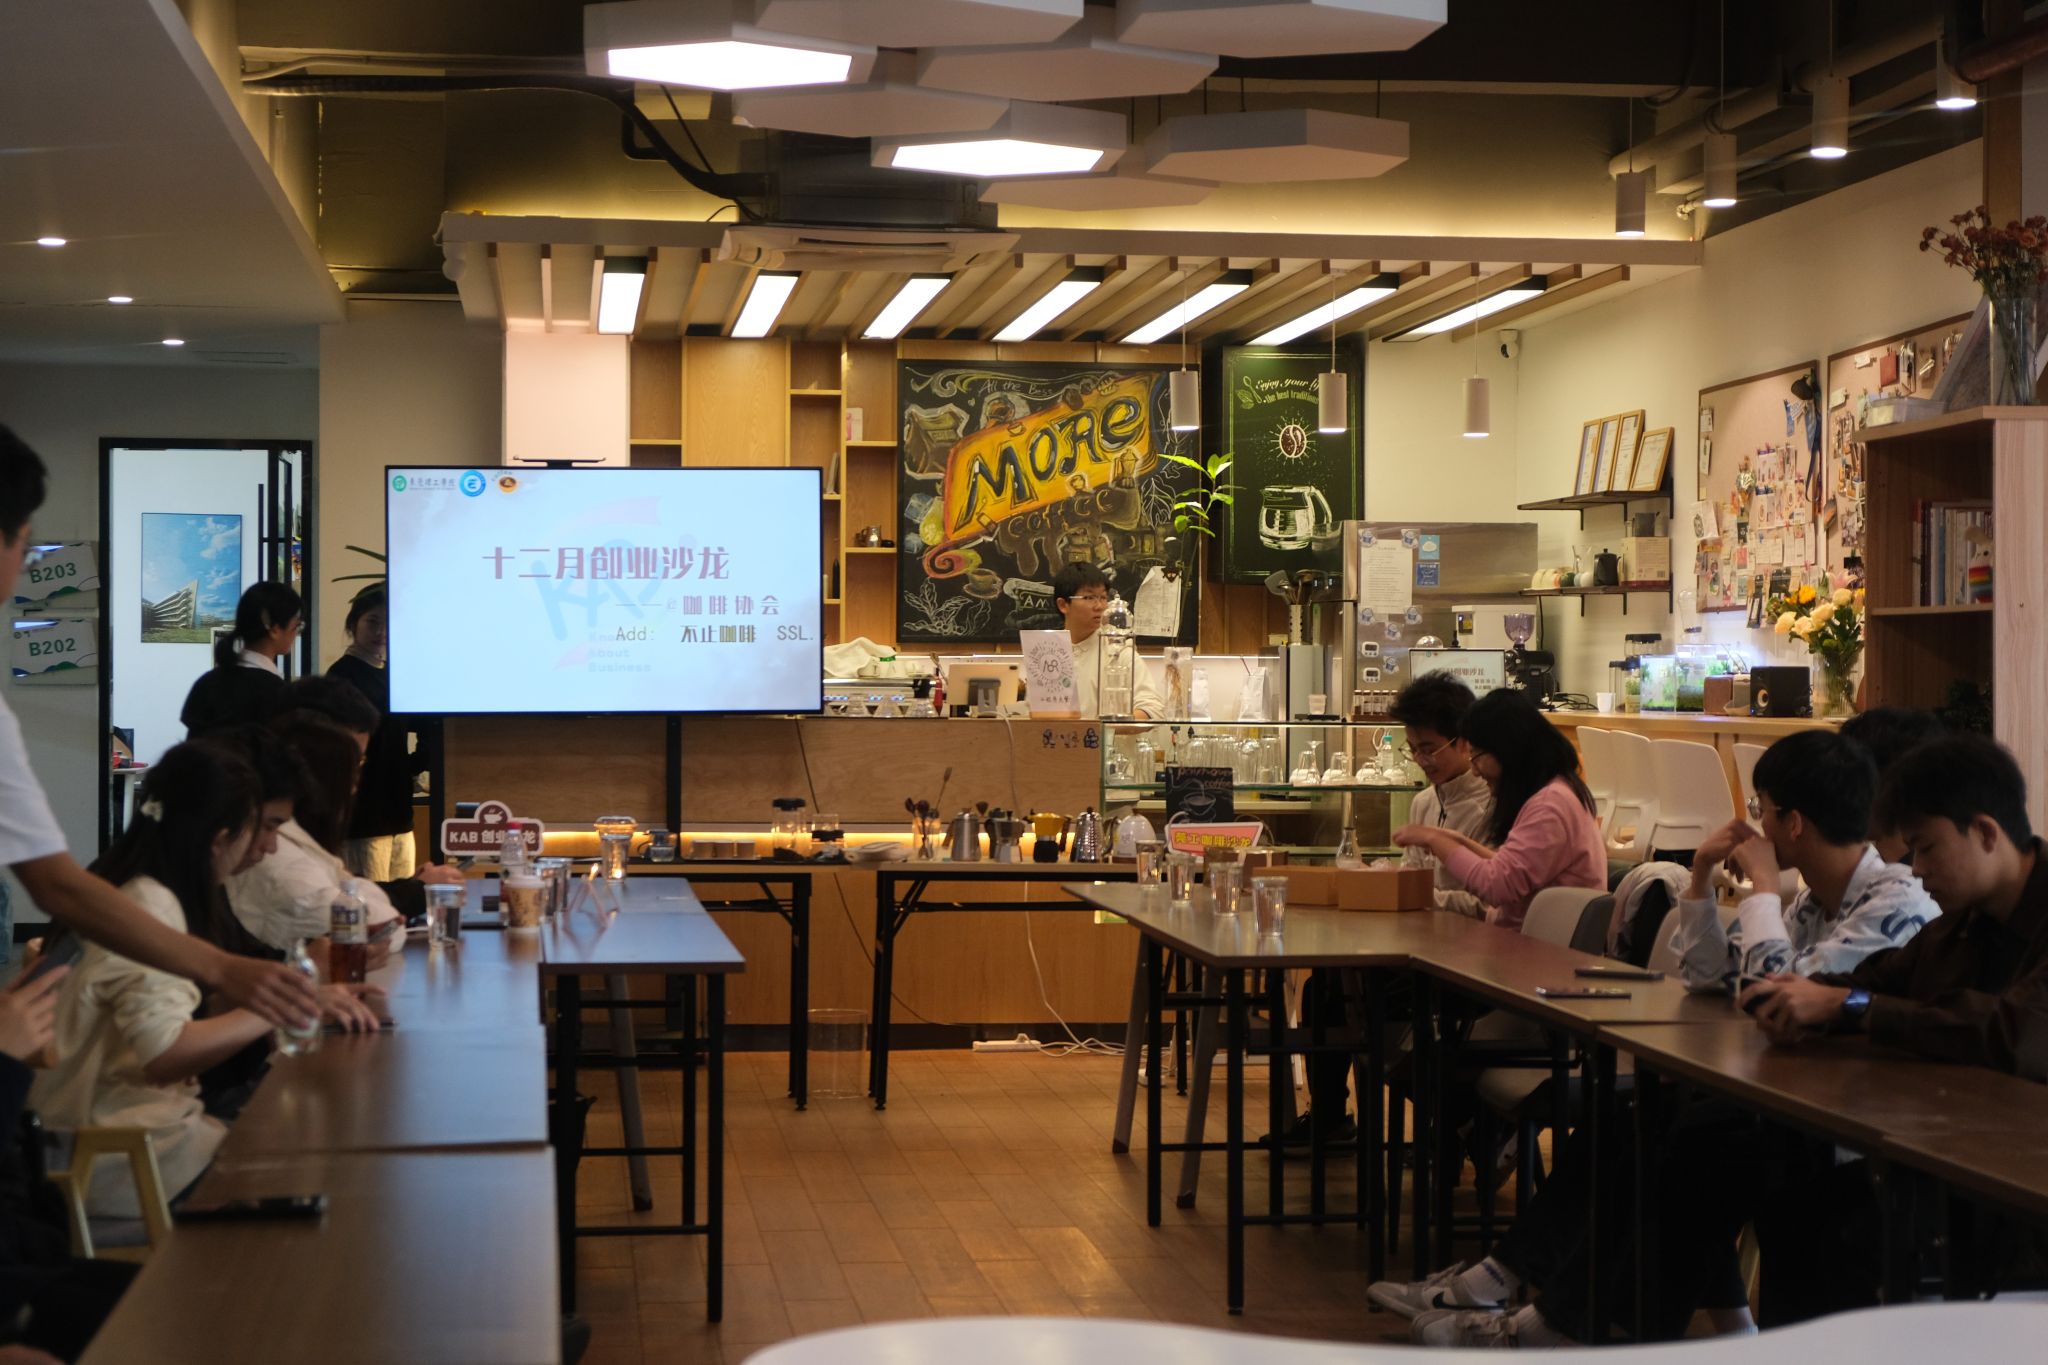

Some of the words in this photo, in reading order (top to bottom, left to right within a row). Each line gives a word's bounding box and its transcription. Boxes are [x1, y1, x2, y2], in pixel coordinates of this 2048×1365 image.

[1255, 379, 1279, 392] Enjoy
[1280, 378, 1309, 388] your
[482, 545, 730, 580] 十二月创业沙龙
[29, 562, 77, 584] B203
[615, 625, 655, 641] Add:
[680, 624, 756, 643] 不止咖啡
[776, 625, 814, 641] SSL.
[29, 637, 76, 656] B202
[449, 831, 478, 843] KAB
[481, 829, 537, 845] 创业龙
